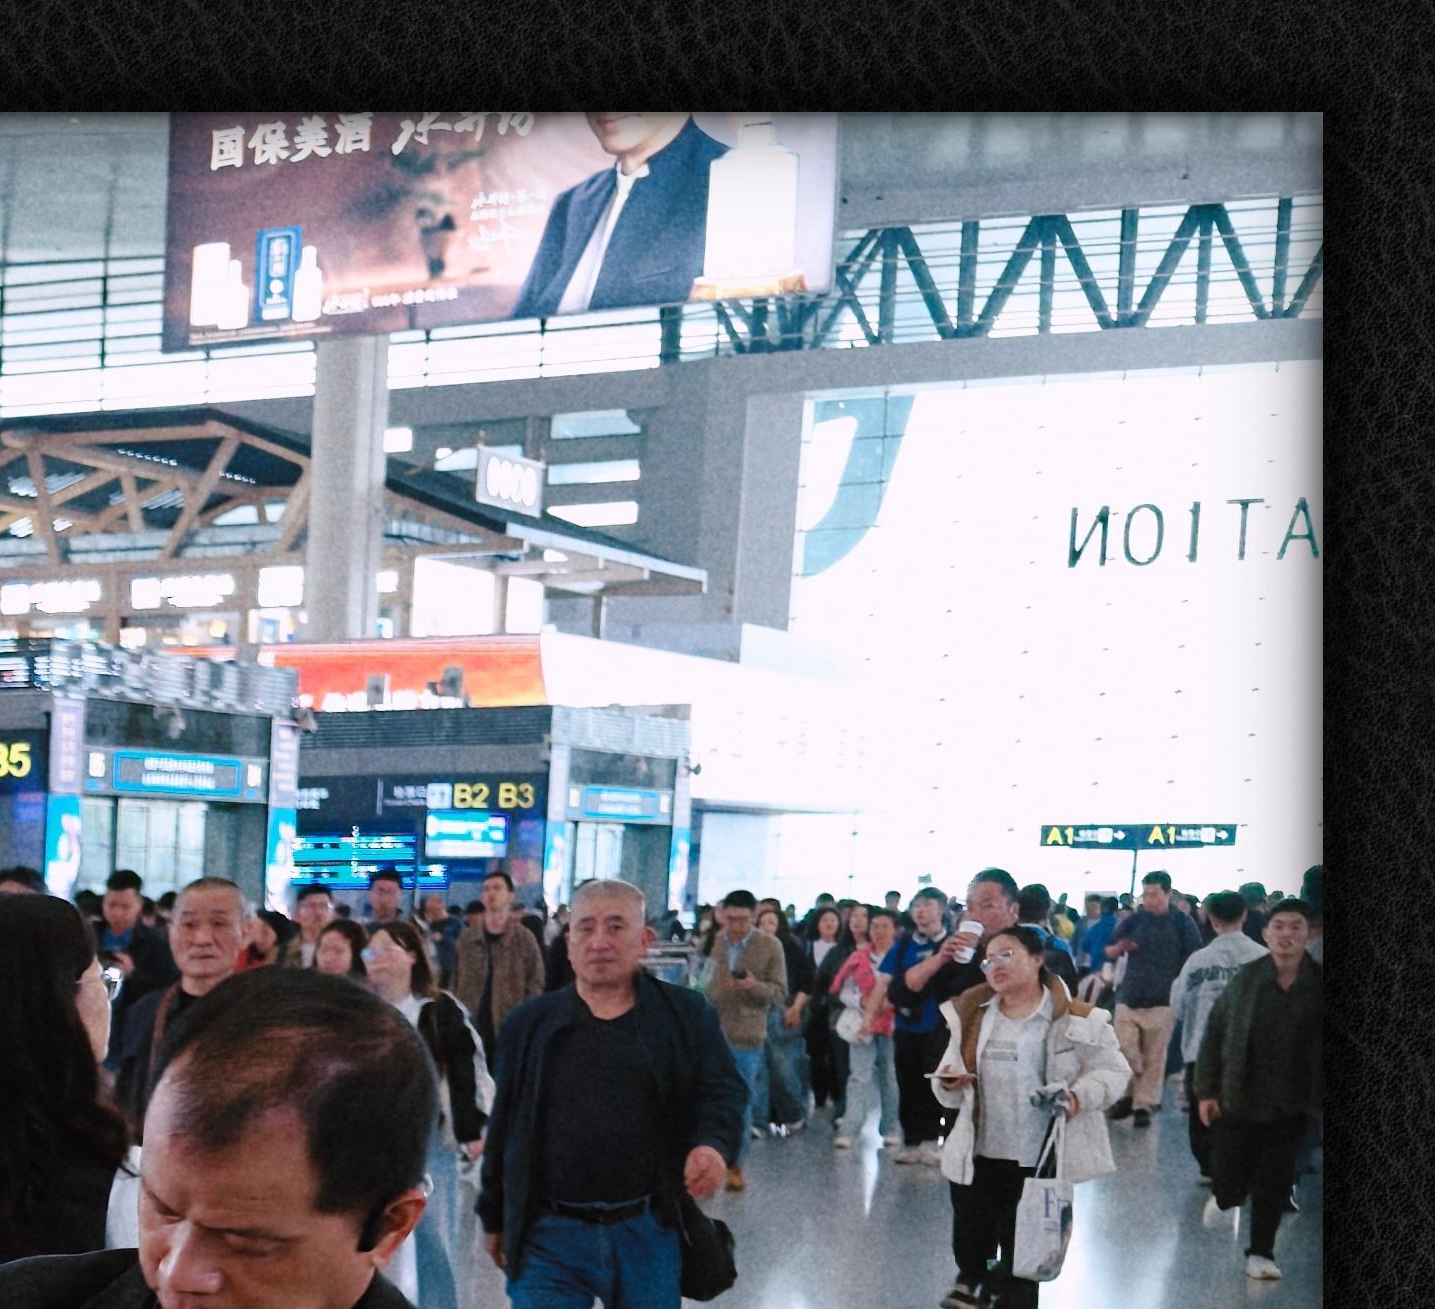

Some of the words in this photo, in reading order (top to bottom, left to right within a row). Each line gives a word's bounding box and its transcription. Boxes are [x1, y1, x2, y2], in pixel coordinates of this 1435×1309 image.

[209, 112, 374, 170] 国保美酒
[453, 782, 490, 809] B2
[498, 782, 535, 809] B3
[1046, 826, 1074, 845] A1
[1147, 826, 1176, 845] A1
